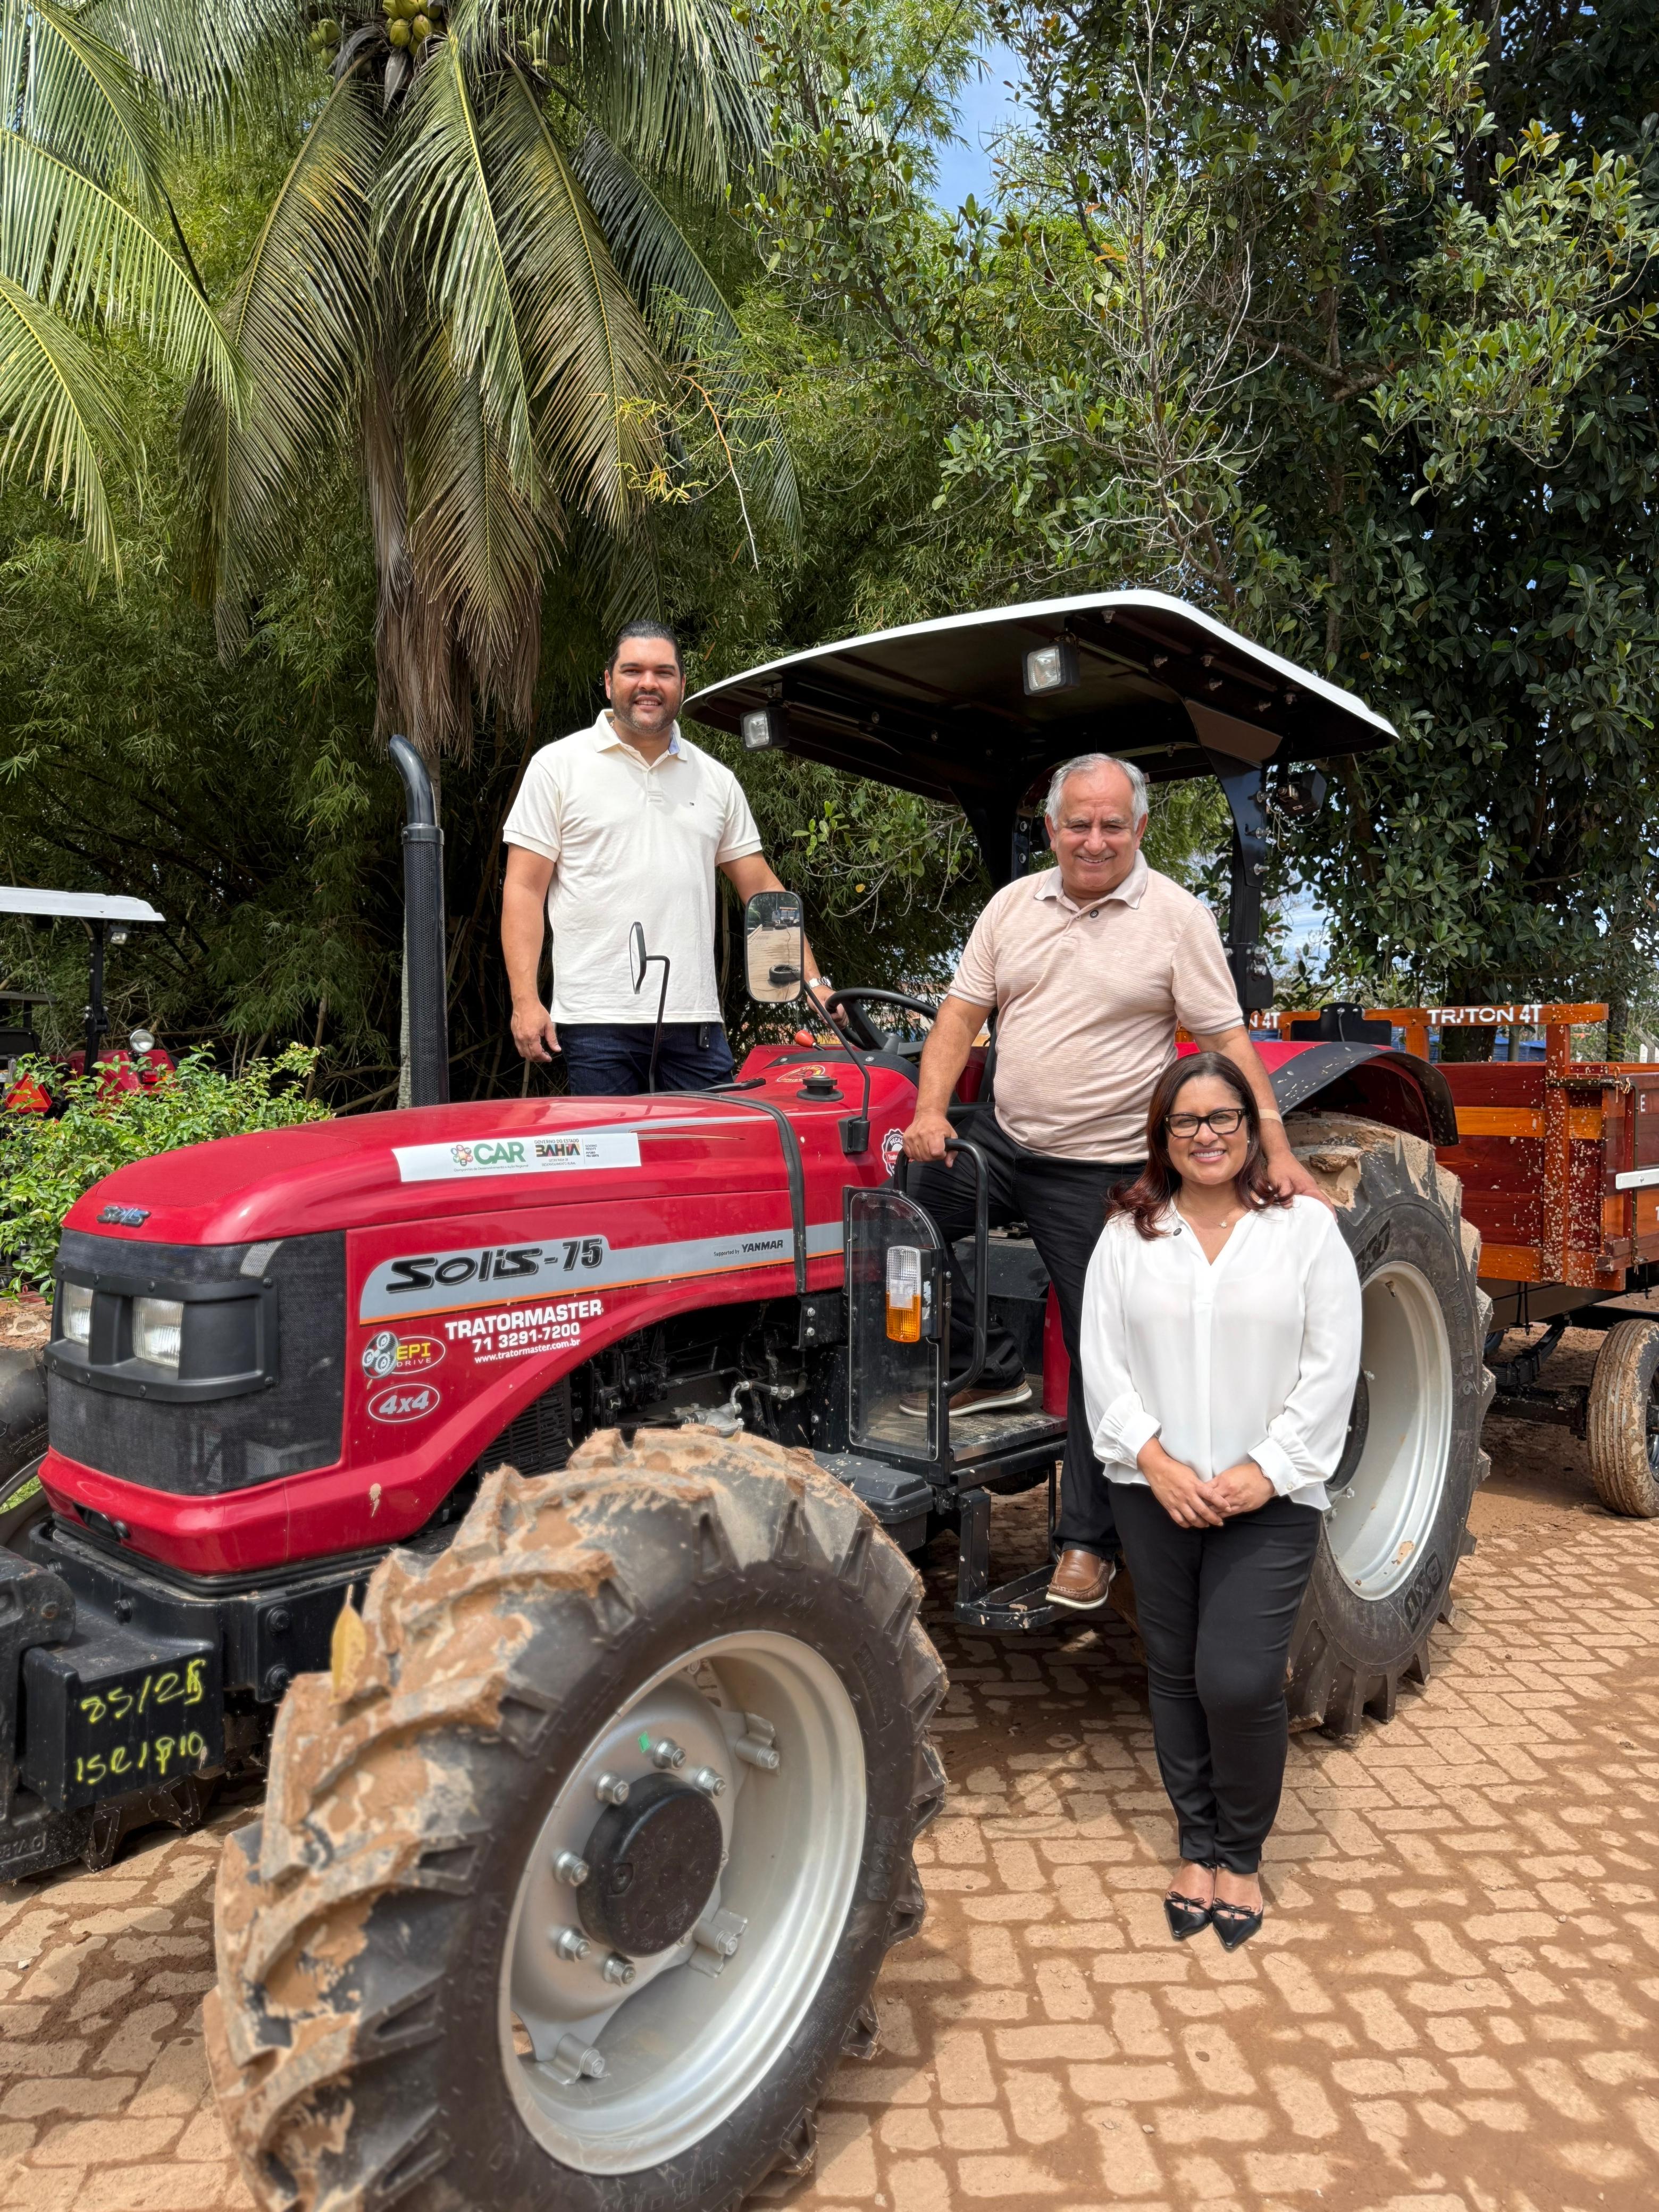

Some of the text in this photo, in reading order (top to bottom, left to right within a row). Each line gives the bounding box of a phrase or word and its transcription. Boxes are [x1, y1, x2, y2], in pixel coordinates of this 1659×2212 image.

[1262, 1012, 1281, 1029] 4T
[1427, 1004, 1543, 1024] TRITON 4T
[474, 1142, 526, 1165] CAR
[742, 1239, 783, 1253] YANMAR
[445, 1299, 602, 1340] TRATORMASTER
[472, 1322, 580, 1353] 71 3291-7200
[396, 1342, 431, 1360] EPI
[474, 1338, 581, 1364] www.tratormaster.com.br
[397, 1358, 432, 1367] DRIVE
[379, 1390, 430, 1414] 4x4
